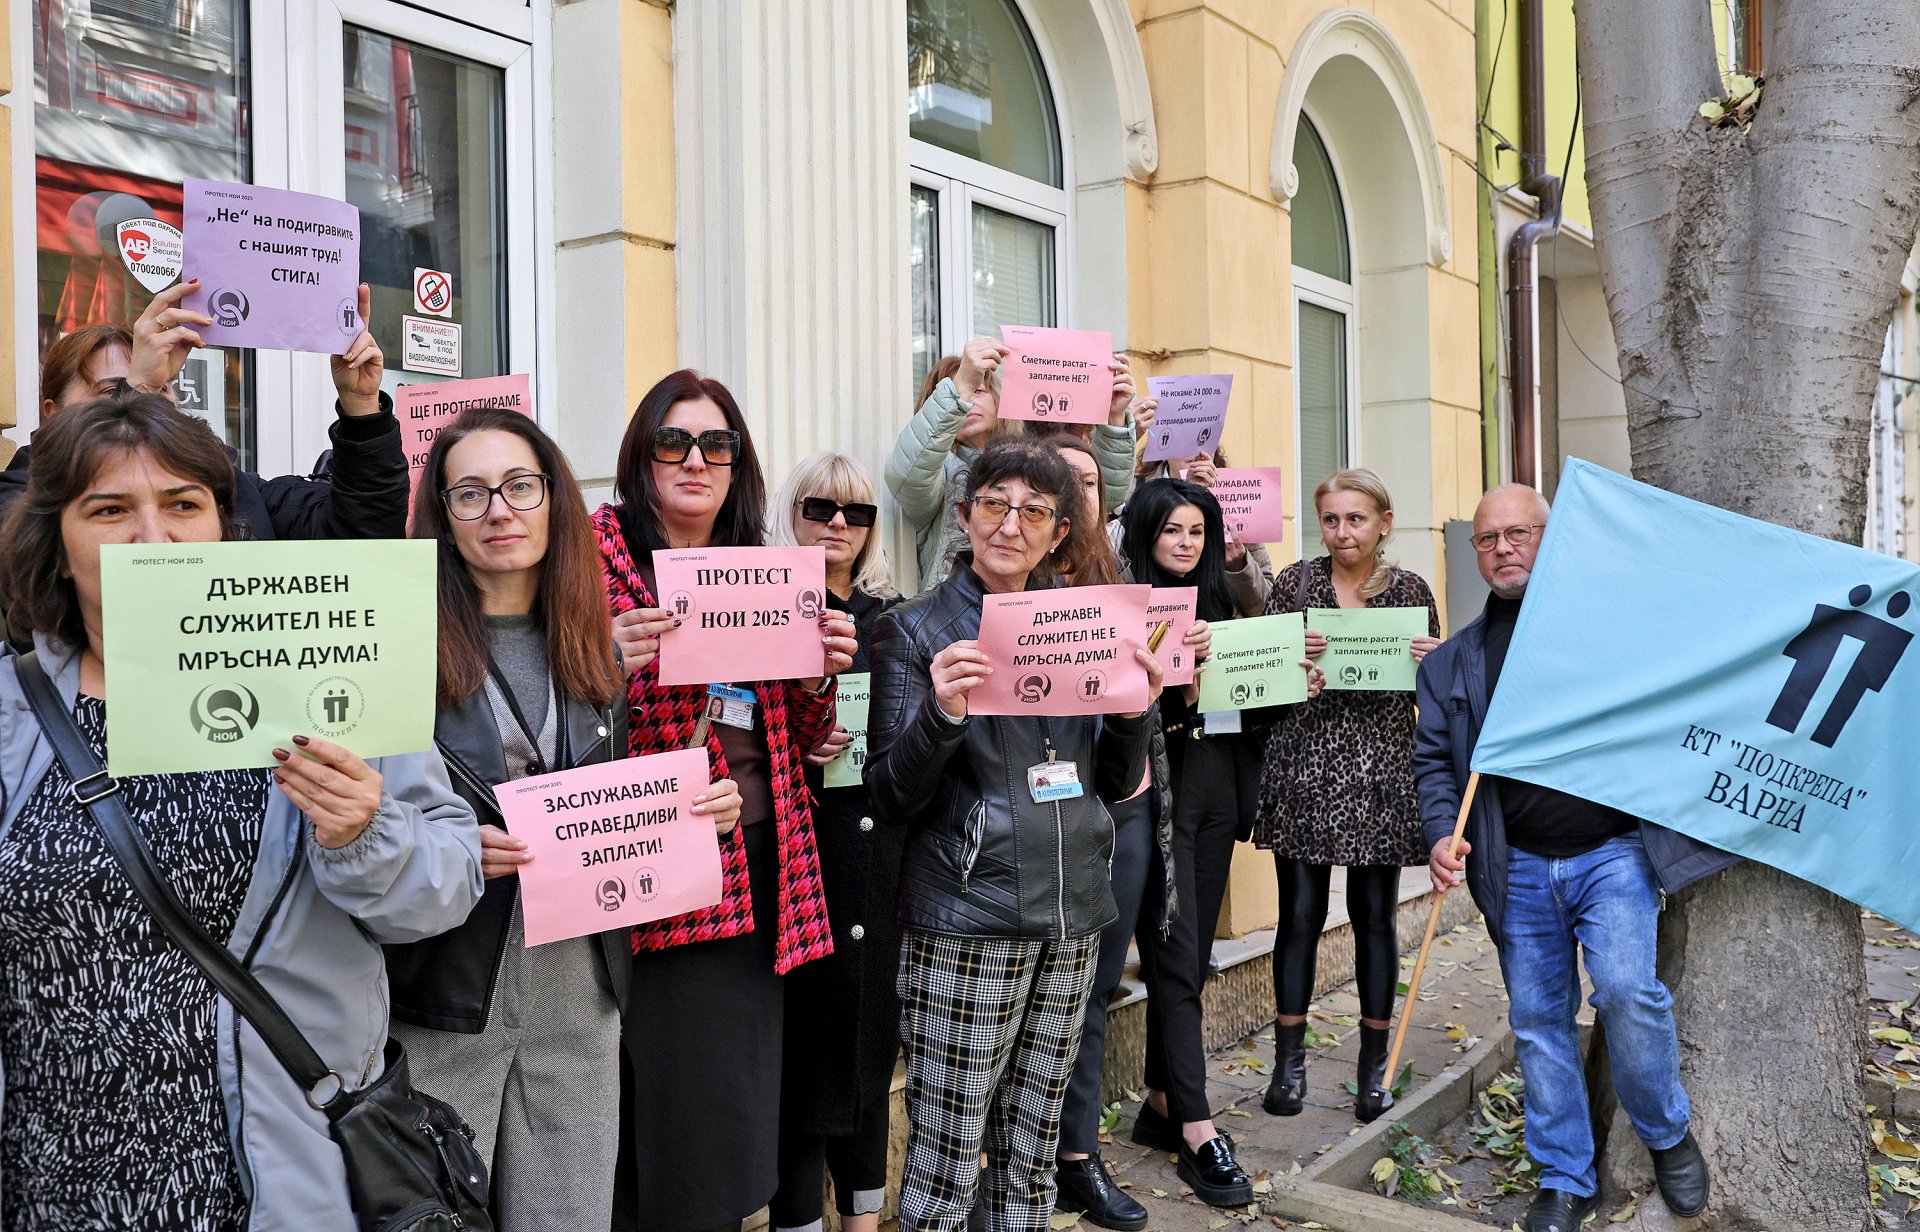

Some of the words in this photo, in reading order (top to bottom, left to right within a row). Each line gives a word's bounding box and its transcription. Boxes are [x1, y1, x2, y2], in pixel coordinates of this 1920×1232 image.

[121, 221, 141, 230] ОБЕКТ
[143, 220, 157, 228] ПОД
[158, 223, 181, 240] ОХРАНА
[207, 207, 249, 223] „Не“
[253, 214, 272, 227] на
[277, 217, 353, 241] подигравките
[125, 238, 149, 254] AB
[153, 239, 181, 249] Solution
[239, 239, 247, 250] с
[252, 241, 308, 257] нашият
[312, 247, 342, 264] труд!
[153, 247, 181, 258] Security
[131, 262, 176, 277] 070020066
[271, 267, 320, 285] СТИГА!
[220, 319, 236, 327] НОИ
[412, 323, 454, 338] ВНИМАНИЕ!!!
[433, 338, 457, 347] ОБЕКТЪТ
[408, 352, 456, 366] ВИДЕОНАБЛЮДЕНИЕ
[442, 347, 453, 355] ПОД
[1022, 355, 1060, 366] Сметките
[1062, 360, 1088, 368] растат
[1029, 372, 1070, 382] заплатите
[1072, 375, 1089, 383] НЕ?!
[1194, 388, 1200, 396] 24
[411, 405, 429, 421] ЩЕ
[433, 394, 521, 416] ПРОТЕСТИРАМЕ
[1160, 416, 1196, 426] справедлива
[1197, 414, 1220, 423] заплата!
[417, 427, 446, 442] ТОЛ
[696, 568, 792, 586] ПРОТЕСТ
[207, 574, 349, 600] ДЪРЖАВЕН
[180, 611, 320, 634] СЛУЖИТЕЛ
[328, 610, 357, 629] НЕ
[364, 609, 376, 627] Е
[701, 611, 746, 629] НОИ
[752, 610, 790, 627] 2025
[1033, 606, 1101, 626] ДЪРЖАВЕН
[1018, 629, 1088, 647] СЛУЖИТЕЛ
[1091, 628, 1106, 640] НЕ
[1110, 627, 1116, 638] Е
[1326, 635, 1367, 643] Сметките
[1370, 636, 1399, 644] растат
[178, 648, 290, 671] МРЪСНА
[298, 643, 379, 670] ДУМА!
[1013, 652, 1072, 666] МРЪСНА
[1075, 648, 1117, 666] ДУМА!
[1217, 649, 1254, 660] Сметките
[1256, 646, 1280, 656] растат
[1381, 648, 1401, 656] НЕ?!
[1225, 663, 1264, 674] заплатите
[1266, 658, 1283, 668] НЕ?!
[837, 692, 851, 702] Не
[213, 731, 238, 742] НОИ
[1680, 724, 1721, 757] КТ
[1731, 739, 1868, 810] "ПОДКРЕПА"
[516, 786, 538, 794] ПРОТЕСТ
[543, 778, 679, 813] ЗАСЛУЖАВАМЕ
[1704, 771, 1808, 833] ВАРНА
[555, 806, 678, 841] СПРАВЕДЛИВИ
[581, 838, 664, 867] ЗАПЛАТИ!
